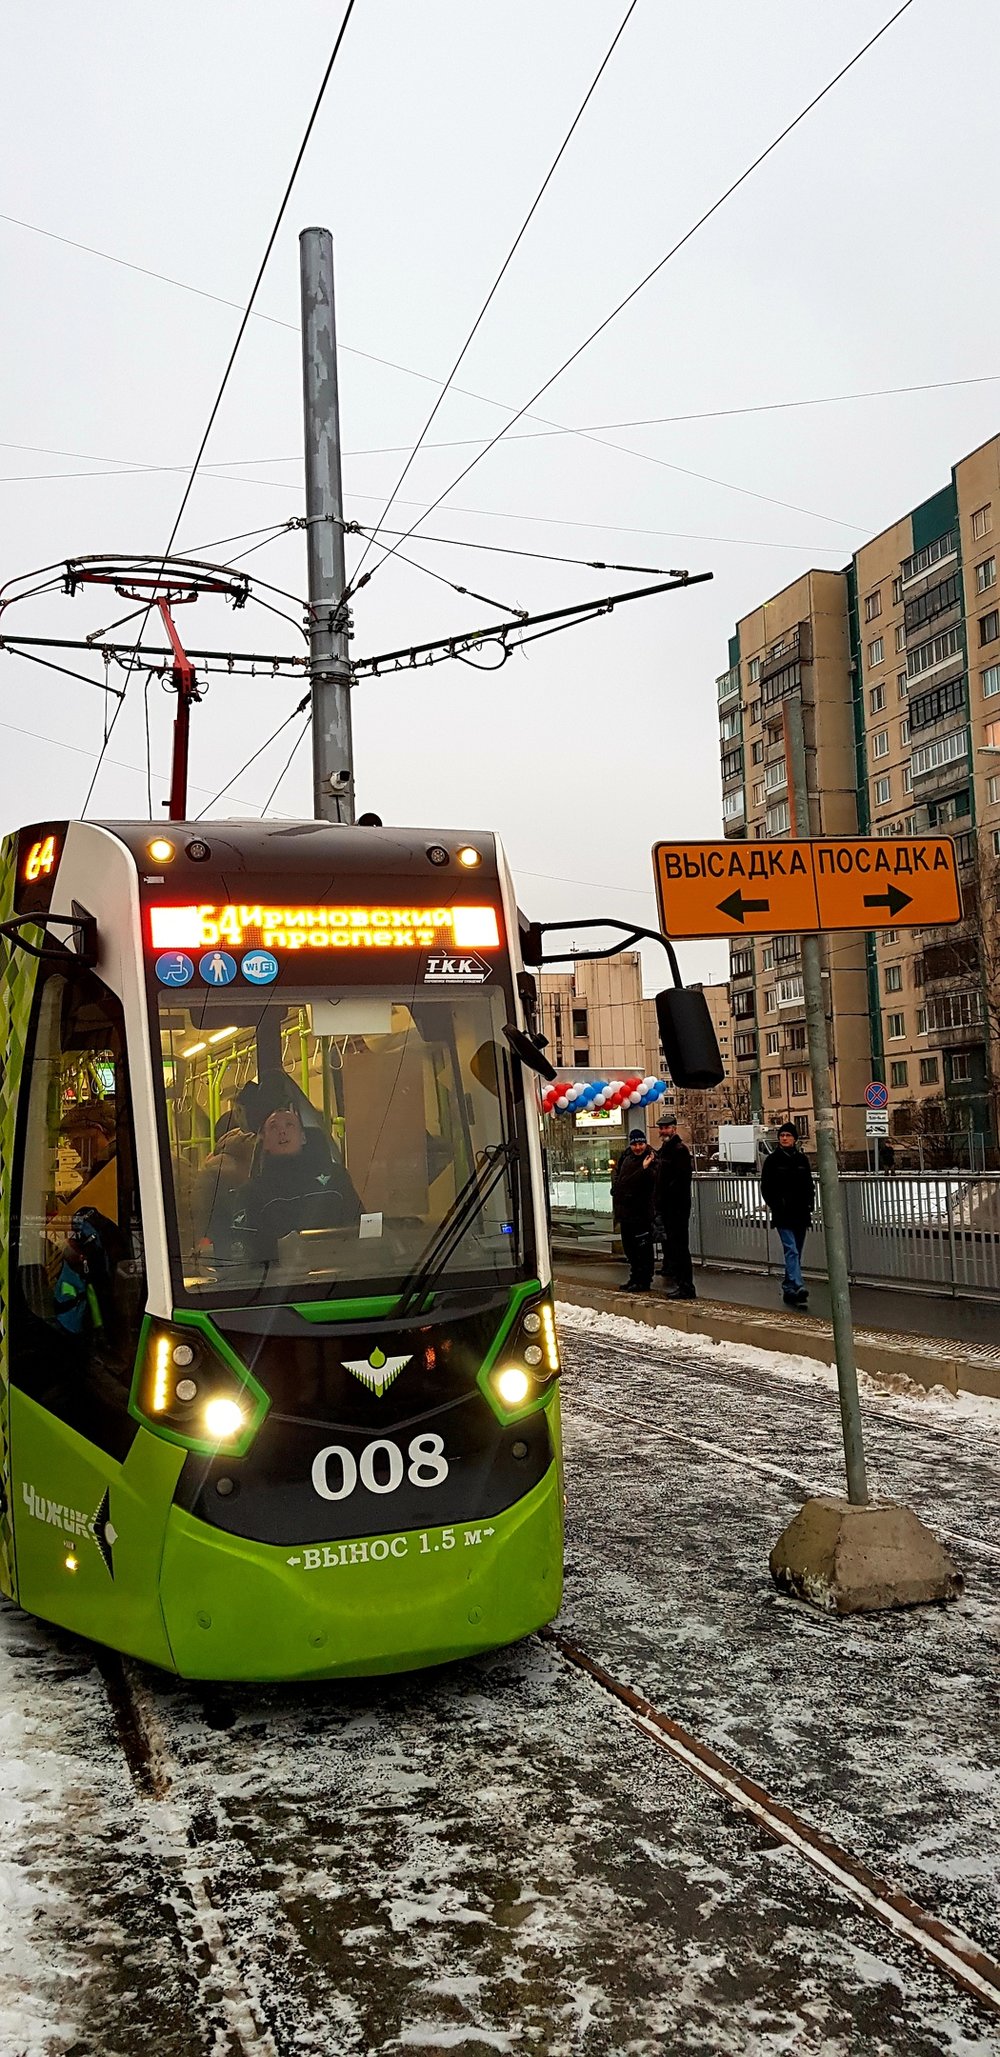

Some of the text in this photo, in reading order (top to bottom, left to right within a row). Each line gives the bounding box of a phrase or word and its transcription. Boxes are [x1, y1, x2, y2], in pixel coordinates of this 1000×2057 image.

[25, 835, 55, 880] 64
[664, 849, 808, 880] ВЫСАДКА
[818, 846, 950, 876] ПОСАДКА
[197, 905, 242, 945] 64
[240, 905, 452, 929] Ириновский
[263, 929, 434, 948] проспект
[427, 959, 473, 973] ТКК
[311, 1433, 449, 1501] 008
[303, 1536, 409, 1570] ВЫНОС
[419, 1528, 456, 1554] 1.5
